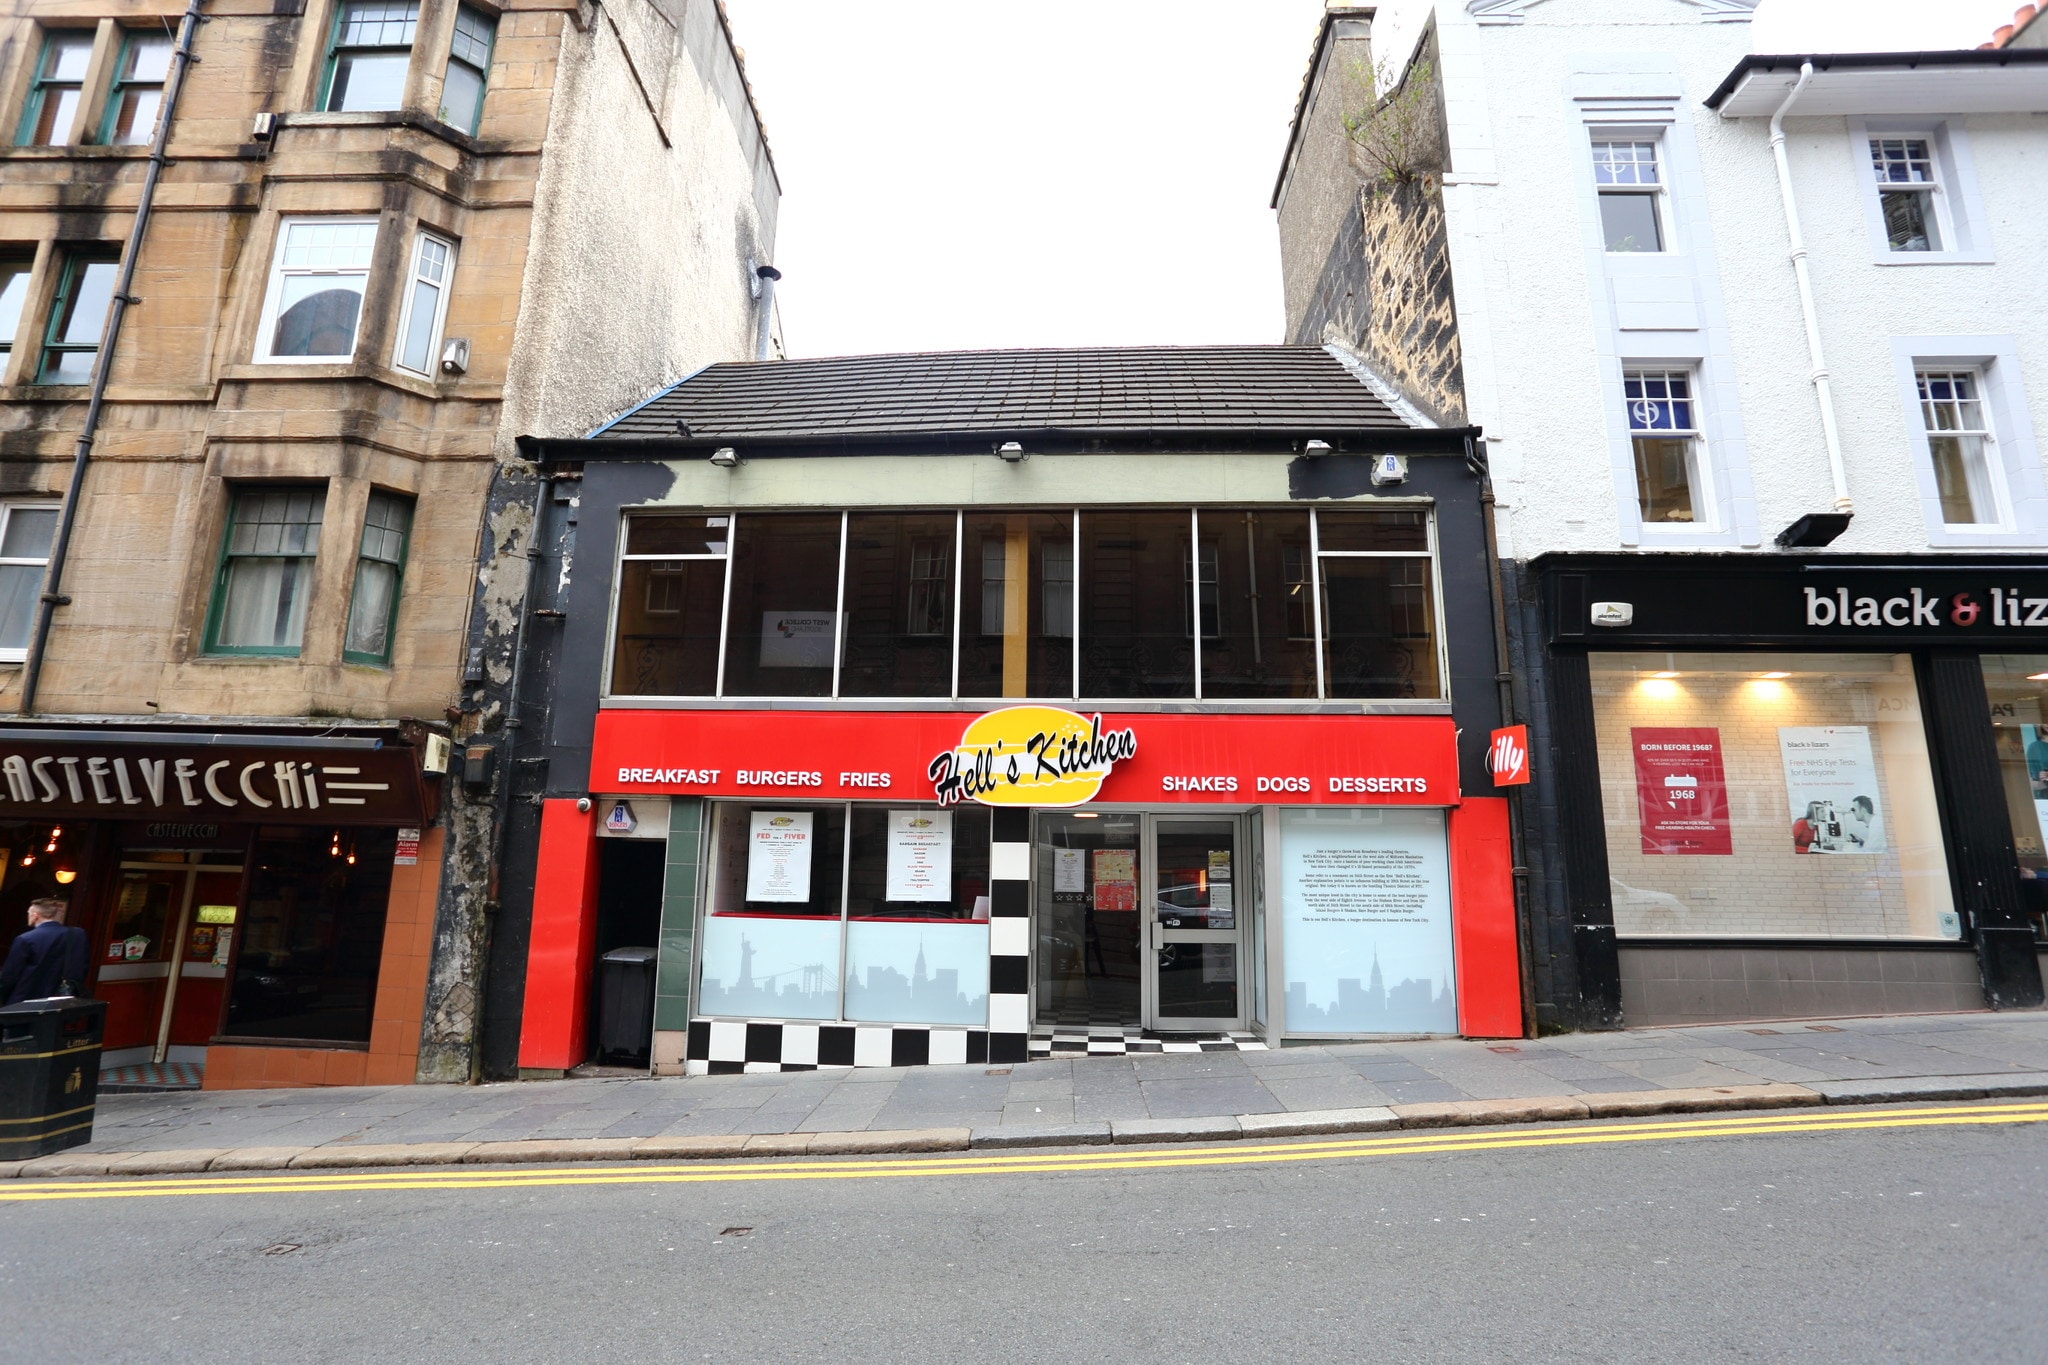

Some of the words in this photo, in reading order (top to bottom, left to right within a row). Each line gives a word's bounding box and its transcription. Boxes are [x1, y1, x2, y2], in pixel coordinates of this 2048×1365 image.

[1804, 588, 1940, 626] black
[1951, 592, 1981, 626] &
[928, 740, 1020, 805] Hell's
[1027, 712, 1136, 778] Kitchen
[1494, 736, 1524, 780] illy
[0, 754, 320, 809] ASTELVECCHI
[618, 768, 720, 784] BREAKFAST
[736, 770, 822, 786] BURGERS
[840, 772, 891, 788] FRIES
[1162, 776, 1238, 792] SHAKES
[1257, 777, 1310, 792] DOGS
[1329, 778, 1427, 793] DESSERTS
[1670, 790, 1695, 799] 1968
